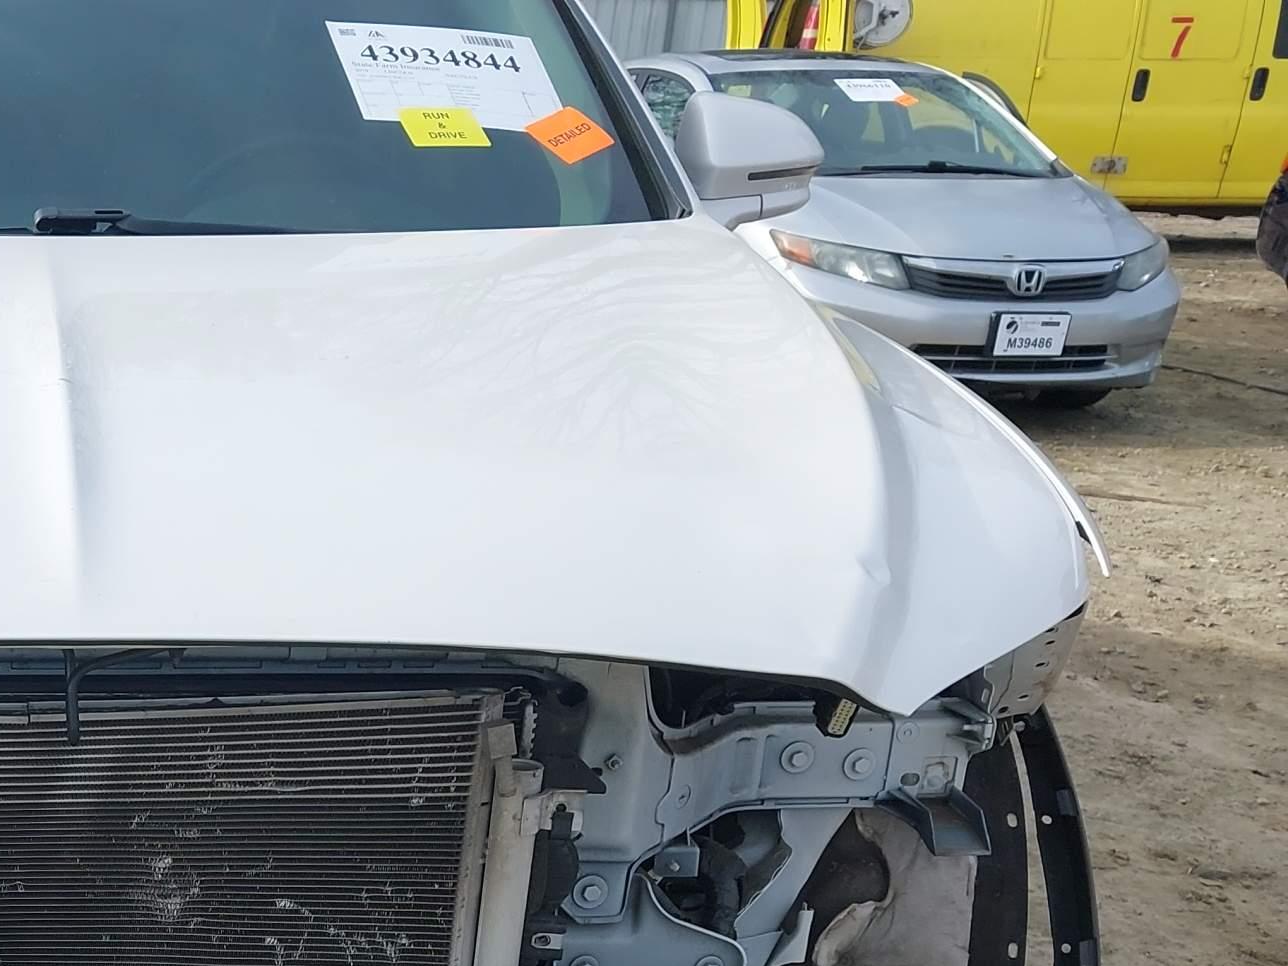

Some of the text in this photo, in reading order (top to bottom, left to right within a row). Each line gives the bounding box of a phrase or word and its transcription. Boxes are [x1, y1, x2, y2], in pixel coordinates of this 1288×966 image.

[1171, 17, 1194, 58] 7
[360, 44, 521, 73] 43934844
[422, 111, 450, 120] RUN
[428, 131, 467, 140] DRIVE
[548, 122, 592, 148] DETAILED
[1006, 337, 1053, 349] M39486
